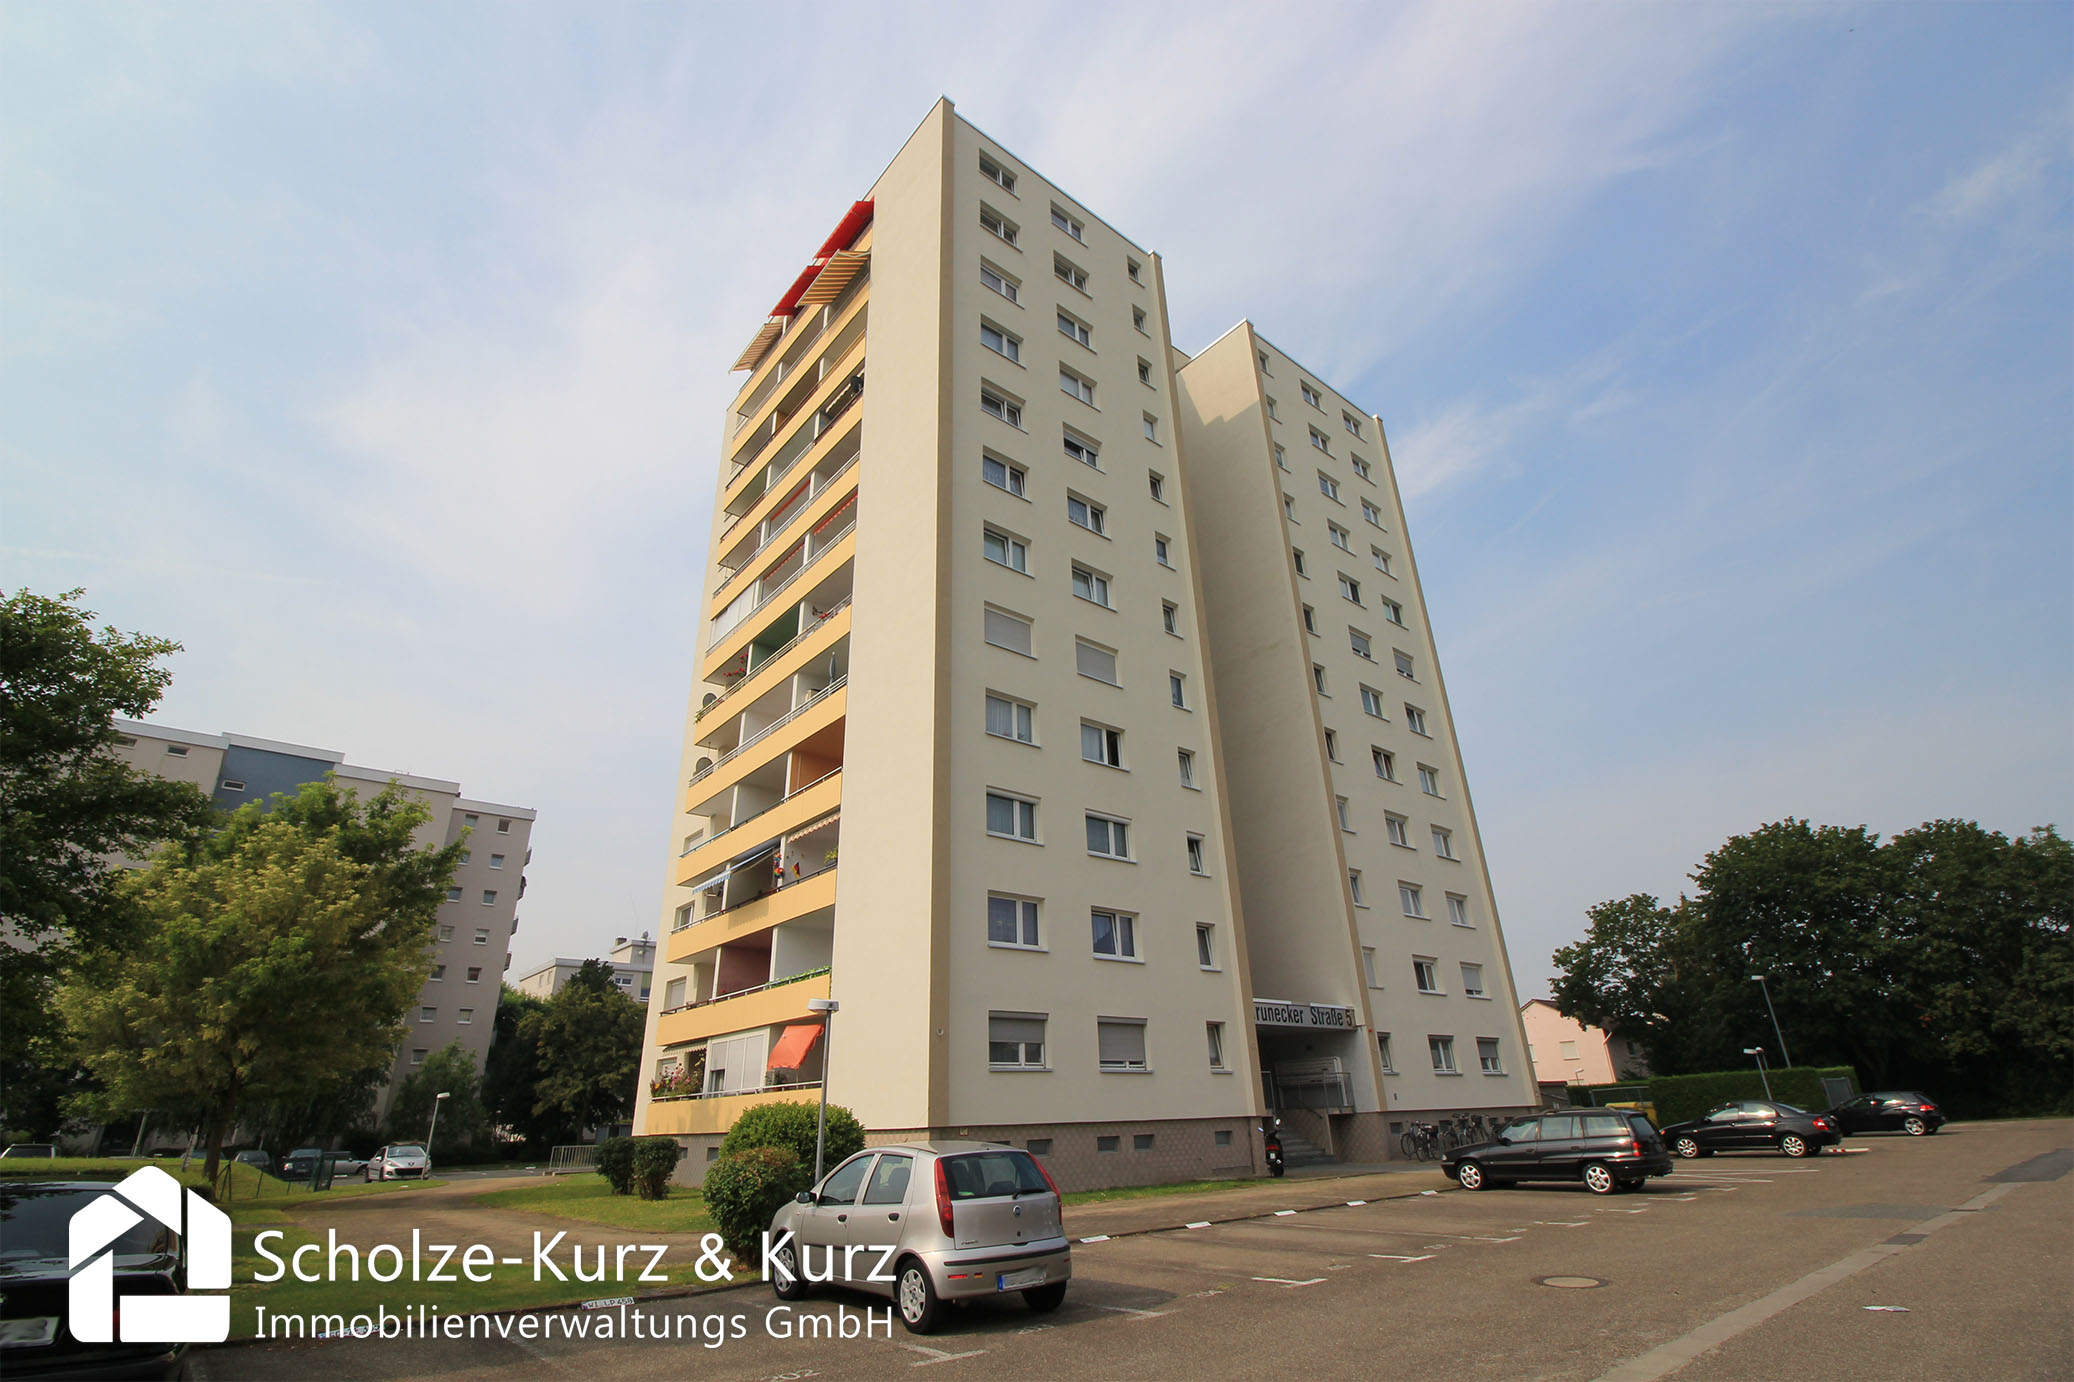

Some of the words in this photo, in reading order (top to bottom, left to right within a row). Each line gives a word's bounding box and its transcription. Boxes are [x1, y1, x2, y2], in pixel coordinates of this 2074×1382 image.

[1254, 1004, 1303, 1024] runecker
[1309, 1006, 1343, 1026] Straße
[1345, 1009, 1353, 1026] 5
